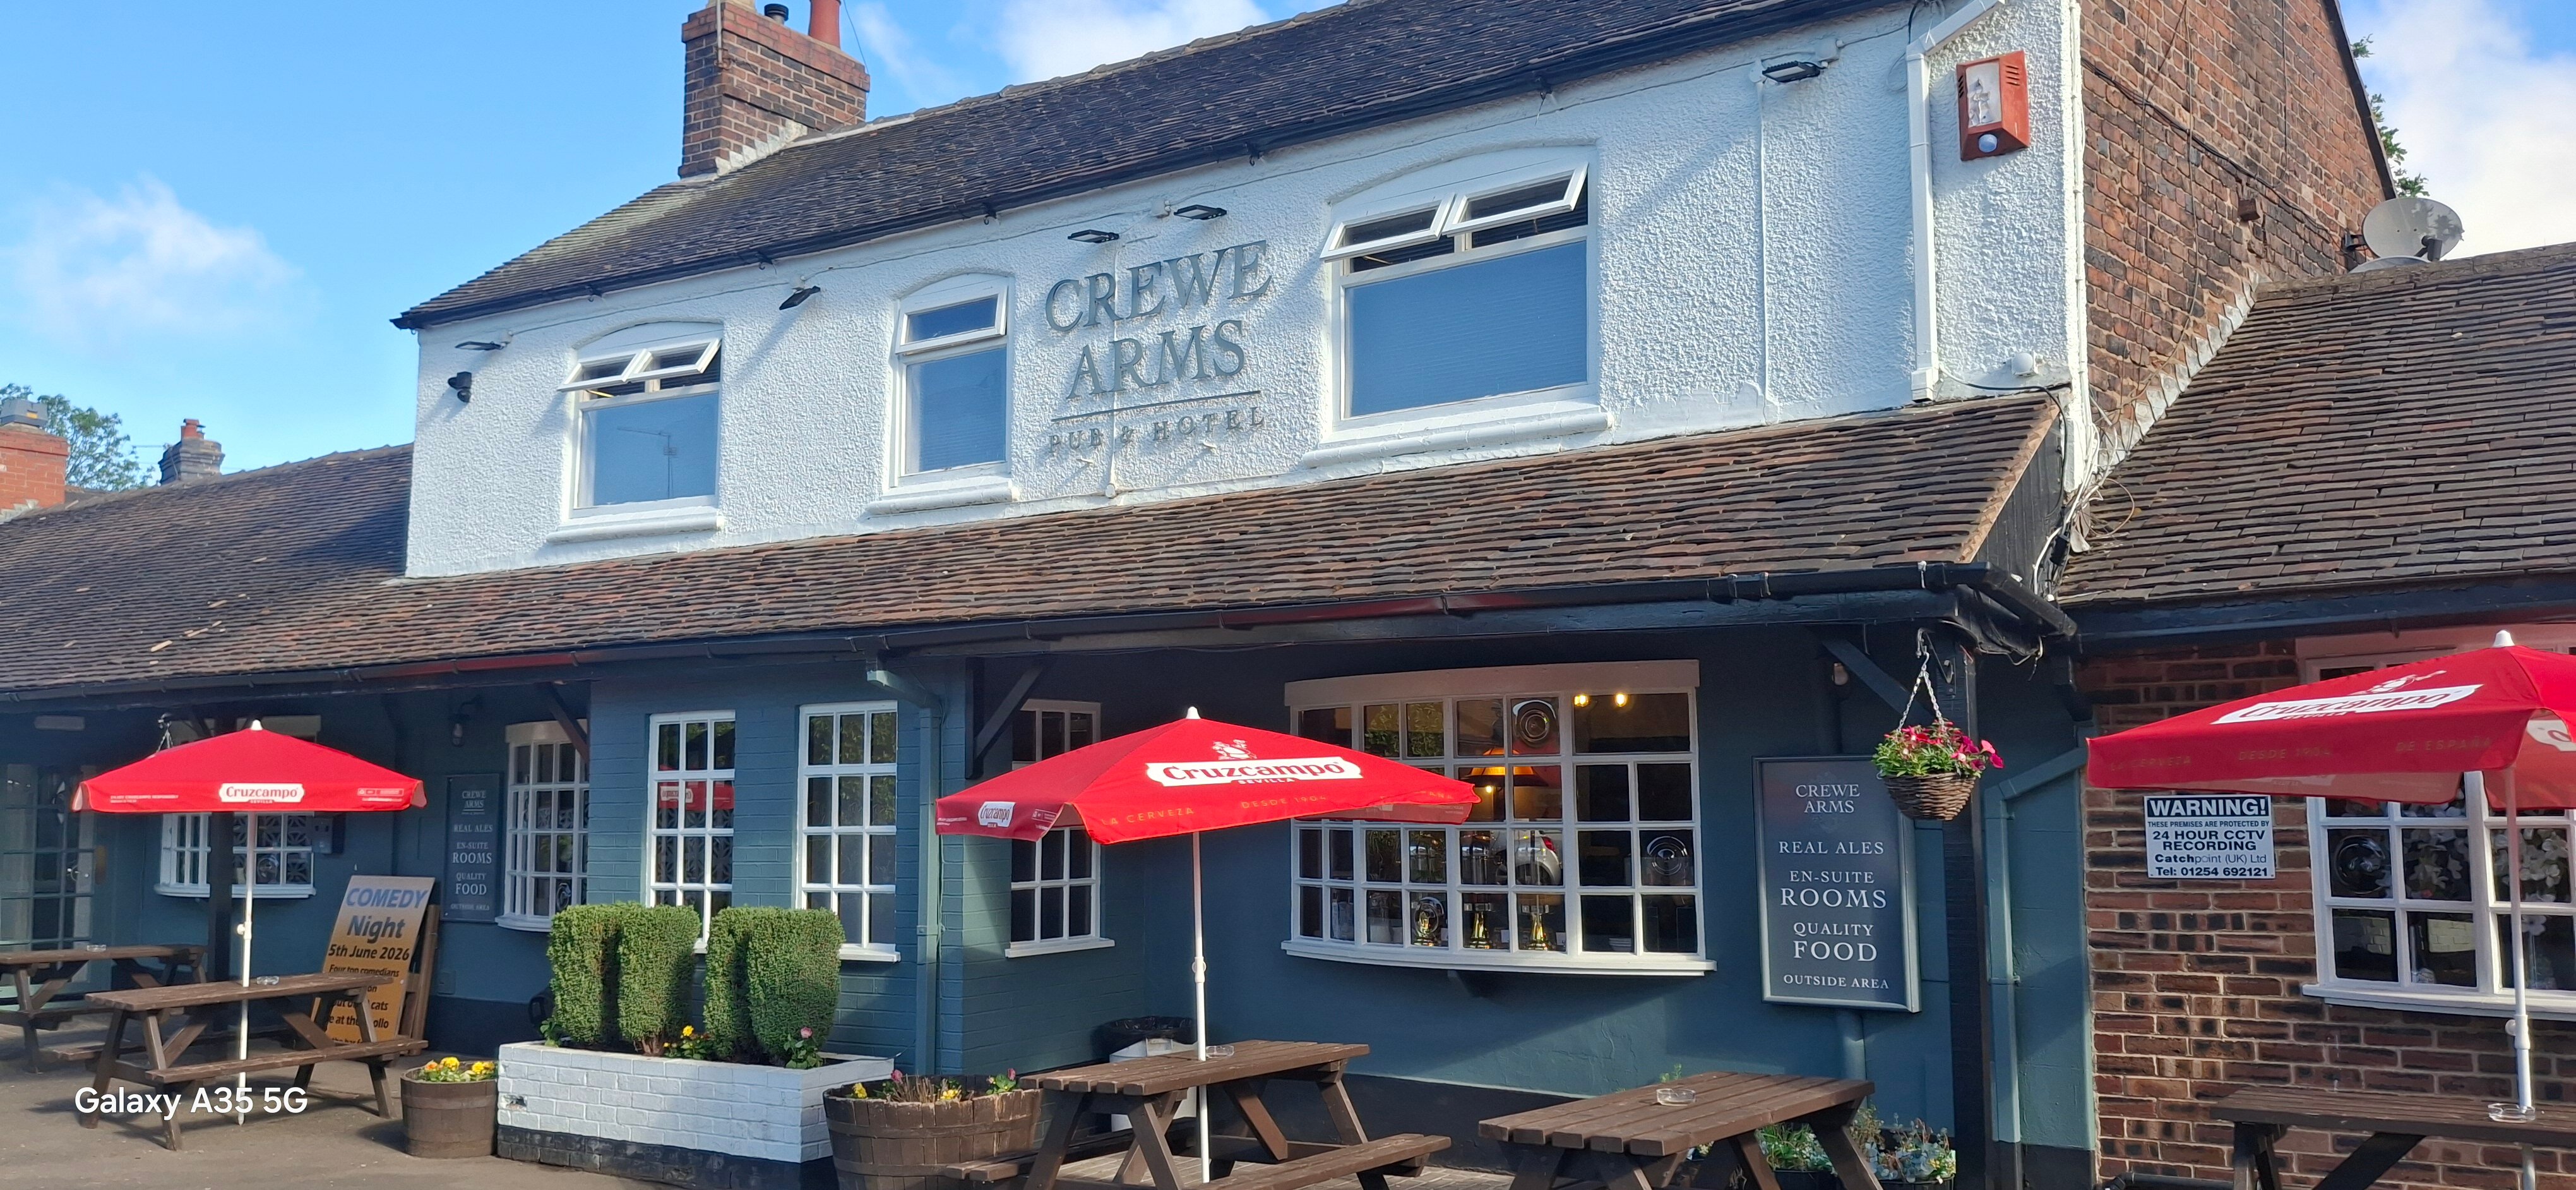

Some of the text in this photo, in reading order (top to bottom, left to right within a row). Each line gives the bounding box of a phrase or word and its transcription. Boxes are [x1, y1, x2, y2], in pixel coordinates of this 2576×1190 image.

[1045, 239, 1272, 332] CREWE
[1066, 320, 1244, 399] ARMS
[1049, 407, 1264, 453] PUB & HOTEL
[2238, 694, 2450, 718] Cruzcampo
[1163, 762, 1345, 780] Cruzcampo
[227, 786, 297, 798] Cruzcampo
[462, 791, 486, 799] CREWE
[1796, 784, 1861, 798] CREWE
[464, 800, 484, 808] ARMS
[1102, 817, 1118, 826] LA
[1127, 807, 1195, 824] CERVEZA
[1241, 797, 1287, 809] DESDE
[1294, 795, 1327, 803] 1904
[1804, 800, 1855, 814] ARMS
[2150, 798, 2267, 816] WARNING!
[981, 805, 1010, 823] Cruzcampo
[454, 824, 493, 832] REAL ALES
[2152, 830, 2265, 840] 24 HOUR CCTV
[456, 841, 488, 850] EN-SUITE
[1779, 841, 1884, 855] REAL ALES
[2163, 841, 2257, 851] RECORDING
[452, 852, 492, 864] ROOMS
[2154, 854, 2267, 865] Catchpoint (UK) Ltd
[456, 872, 486, 881] QUALITY
[1789, 870, 1875, 884] EN-SUITE
[2156, 867, 2268, 877] Tel: 01254 692121
[455, 883, 487, 896] FOOD
[345, 888, 428, 908] COMEDY
[1780, 888, 1887, 909] ROOMS
[347, 915, 405, 943] Night
[1793, 922, 1874, 937] QUALITY
[328, 944, 409, 961] 5th June 2026
[1793, 941, 1878, 962] FOOD
[329, 964, 346, 973] Four
[361, 967, 400, 977] comedians
[1783, 974, 1890, 989] OUTSIDE AREA
[371, 1001, 388, 1011] cats
[336, 1016, 345, 1025] at
[374, 1018, 389, 1028] ollo
